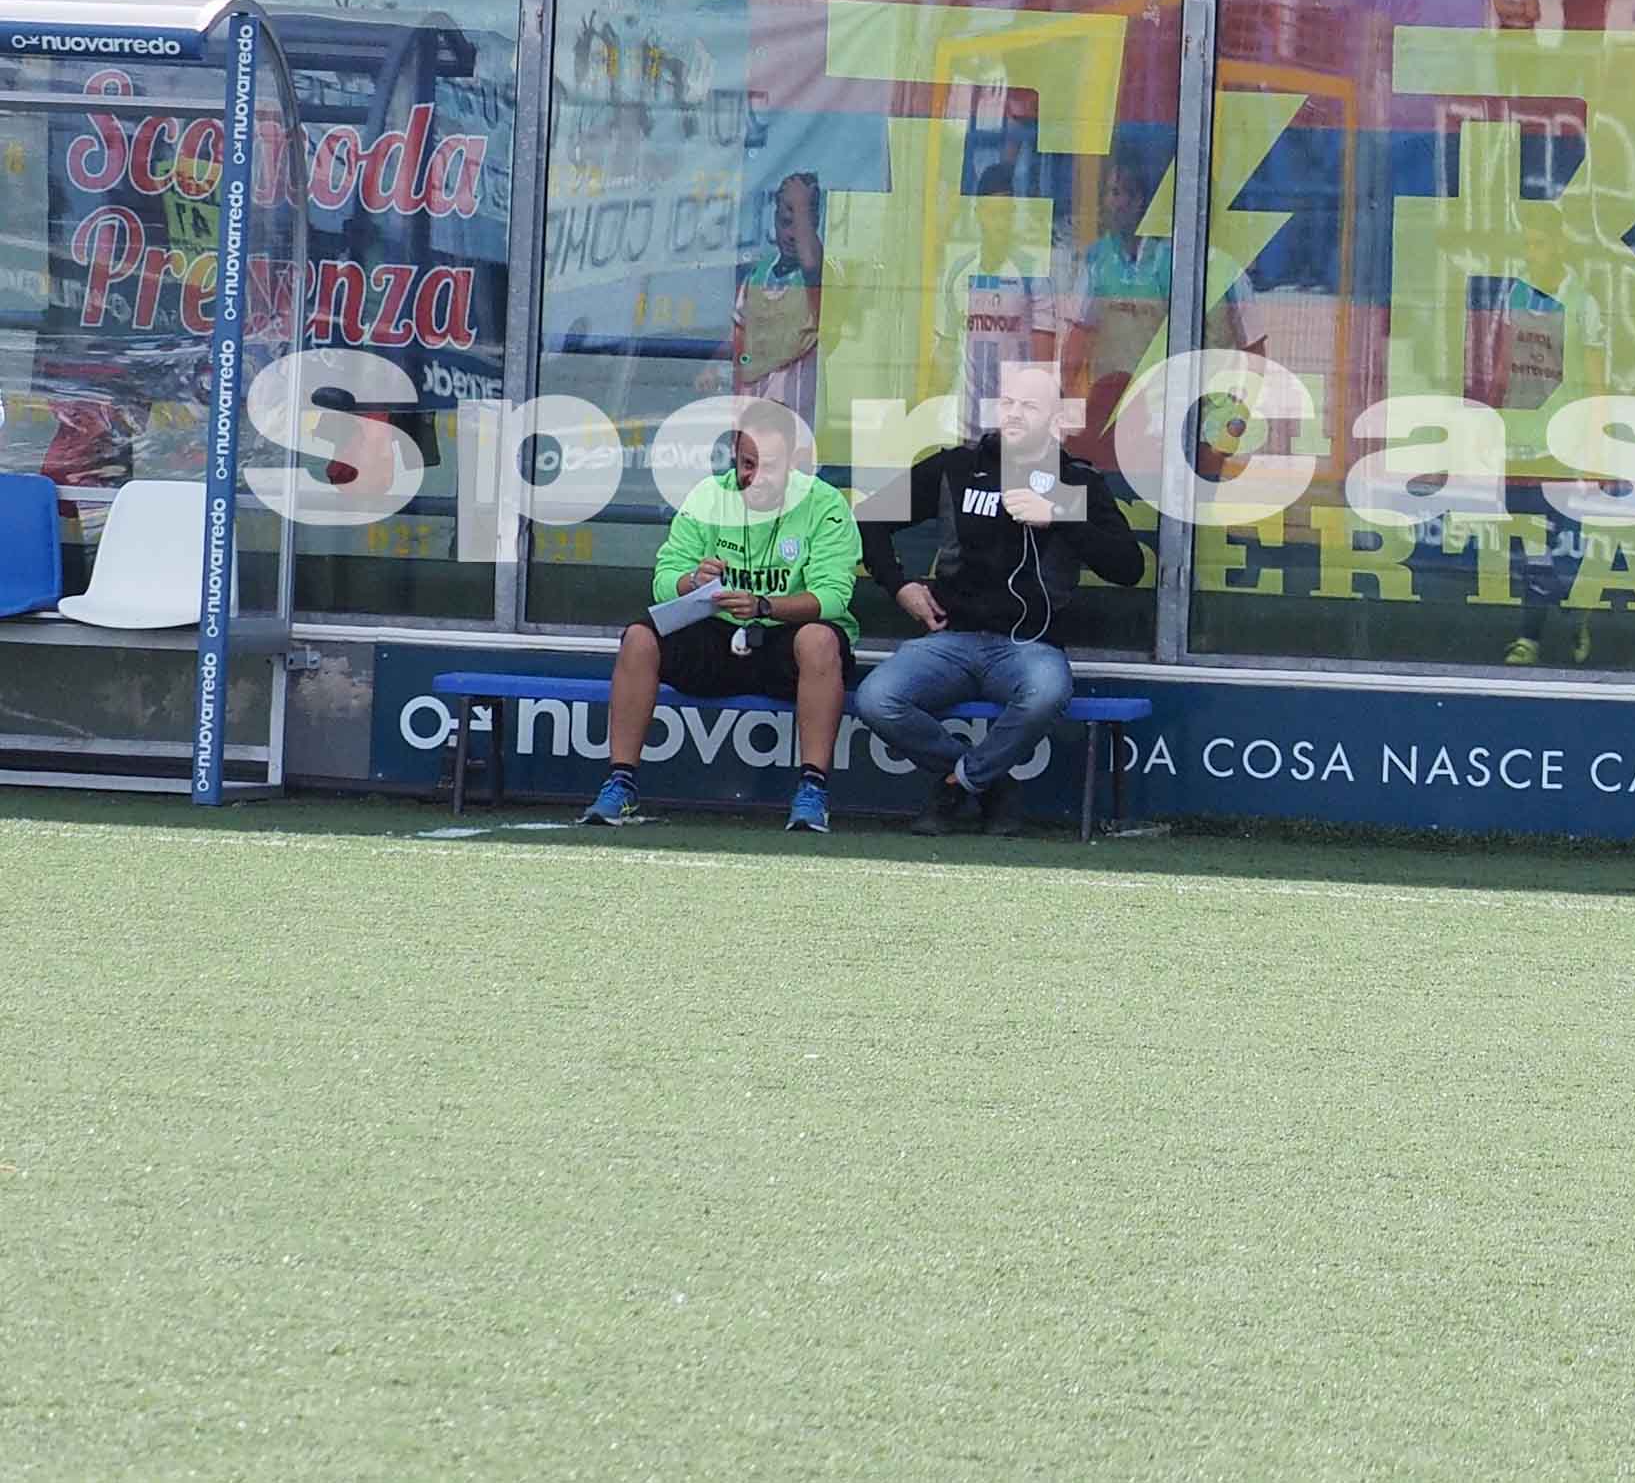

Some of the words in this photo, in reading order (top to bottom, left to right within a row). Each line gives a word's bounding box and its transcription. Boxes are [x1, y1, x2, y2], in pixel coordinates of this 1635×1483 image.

[42, 34, 181, 55] nuovarredo
[233, 24, 255, 140] nuovarredo
[224, 180, 245, 297] nuovarredo
[216, 340, 236, 457] nuovarredo
[207, 498, 228, 613] nuovarredo
[197, 653, 218, 769] nuovarredo
[1108, 734, 1178, 777] DA
[1202, 737, 1354, 784] COSA
[1382, 745, 1564, 790] NASCE
